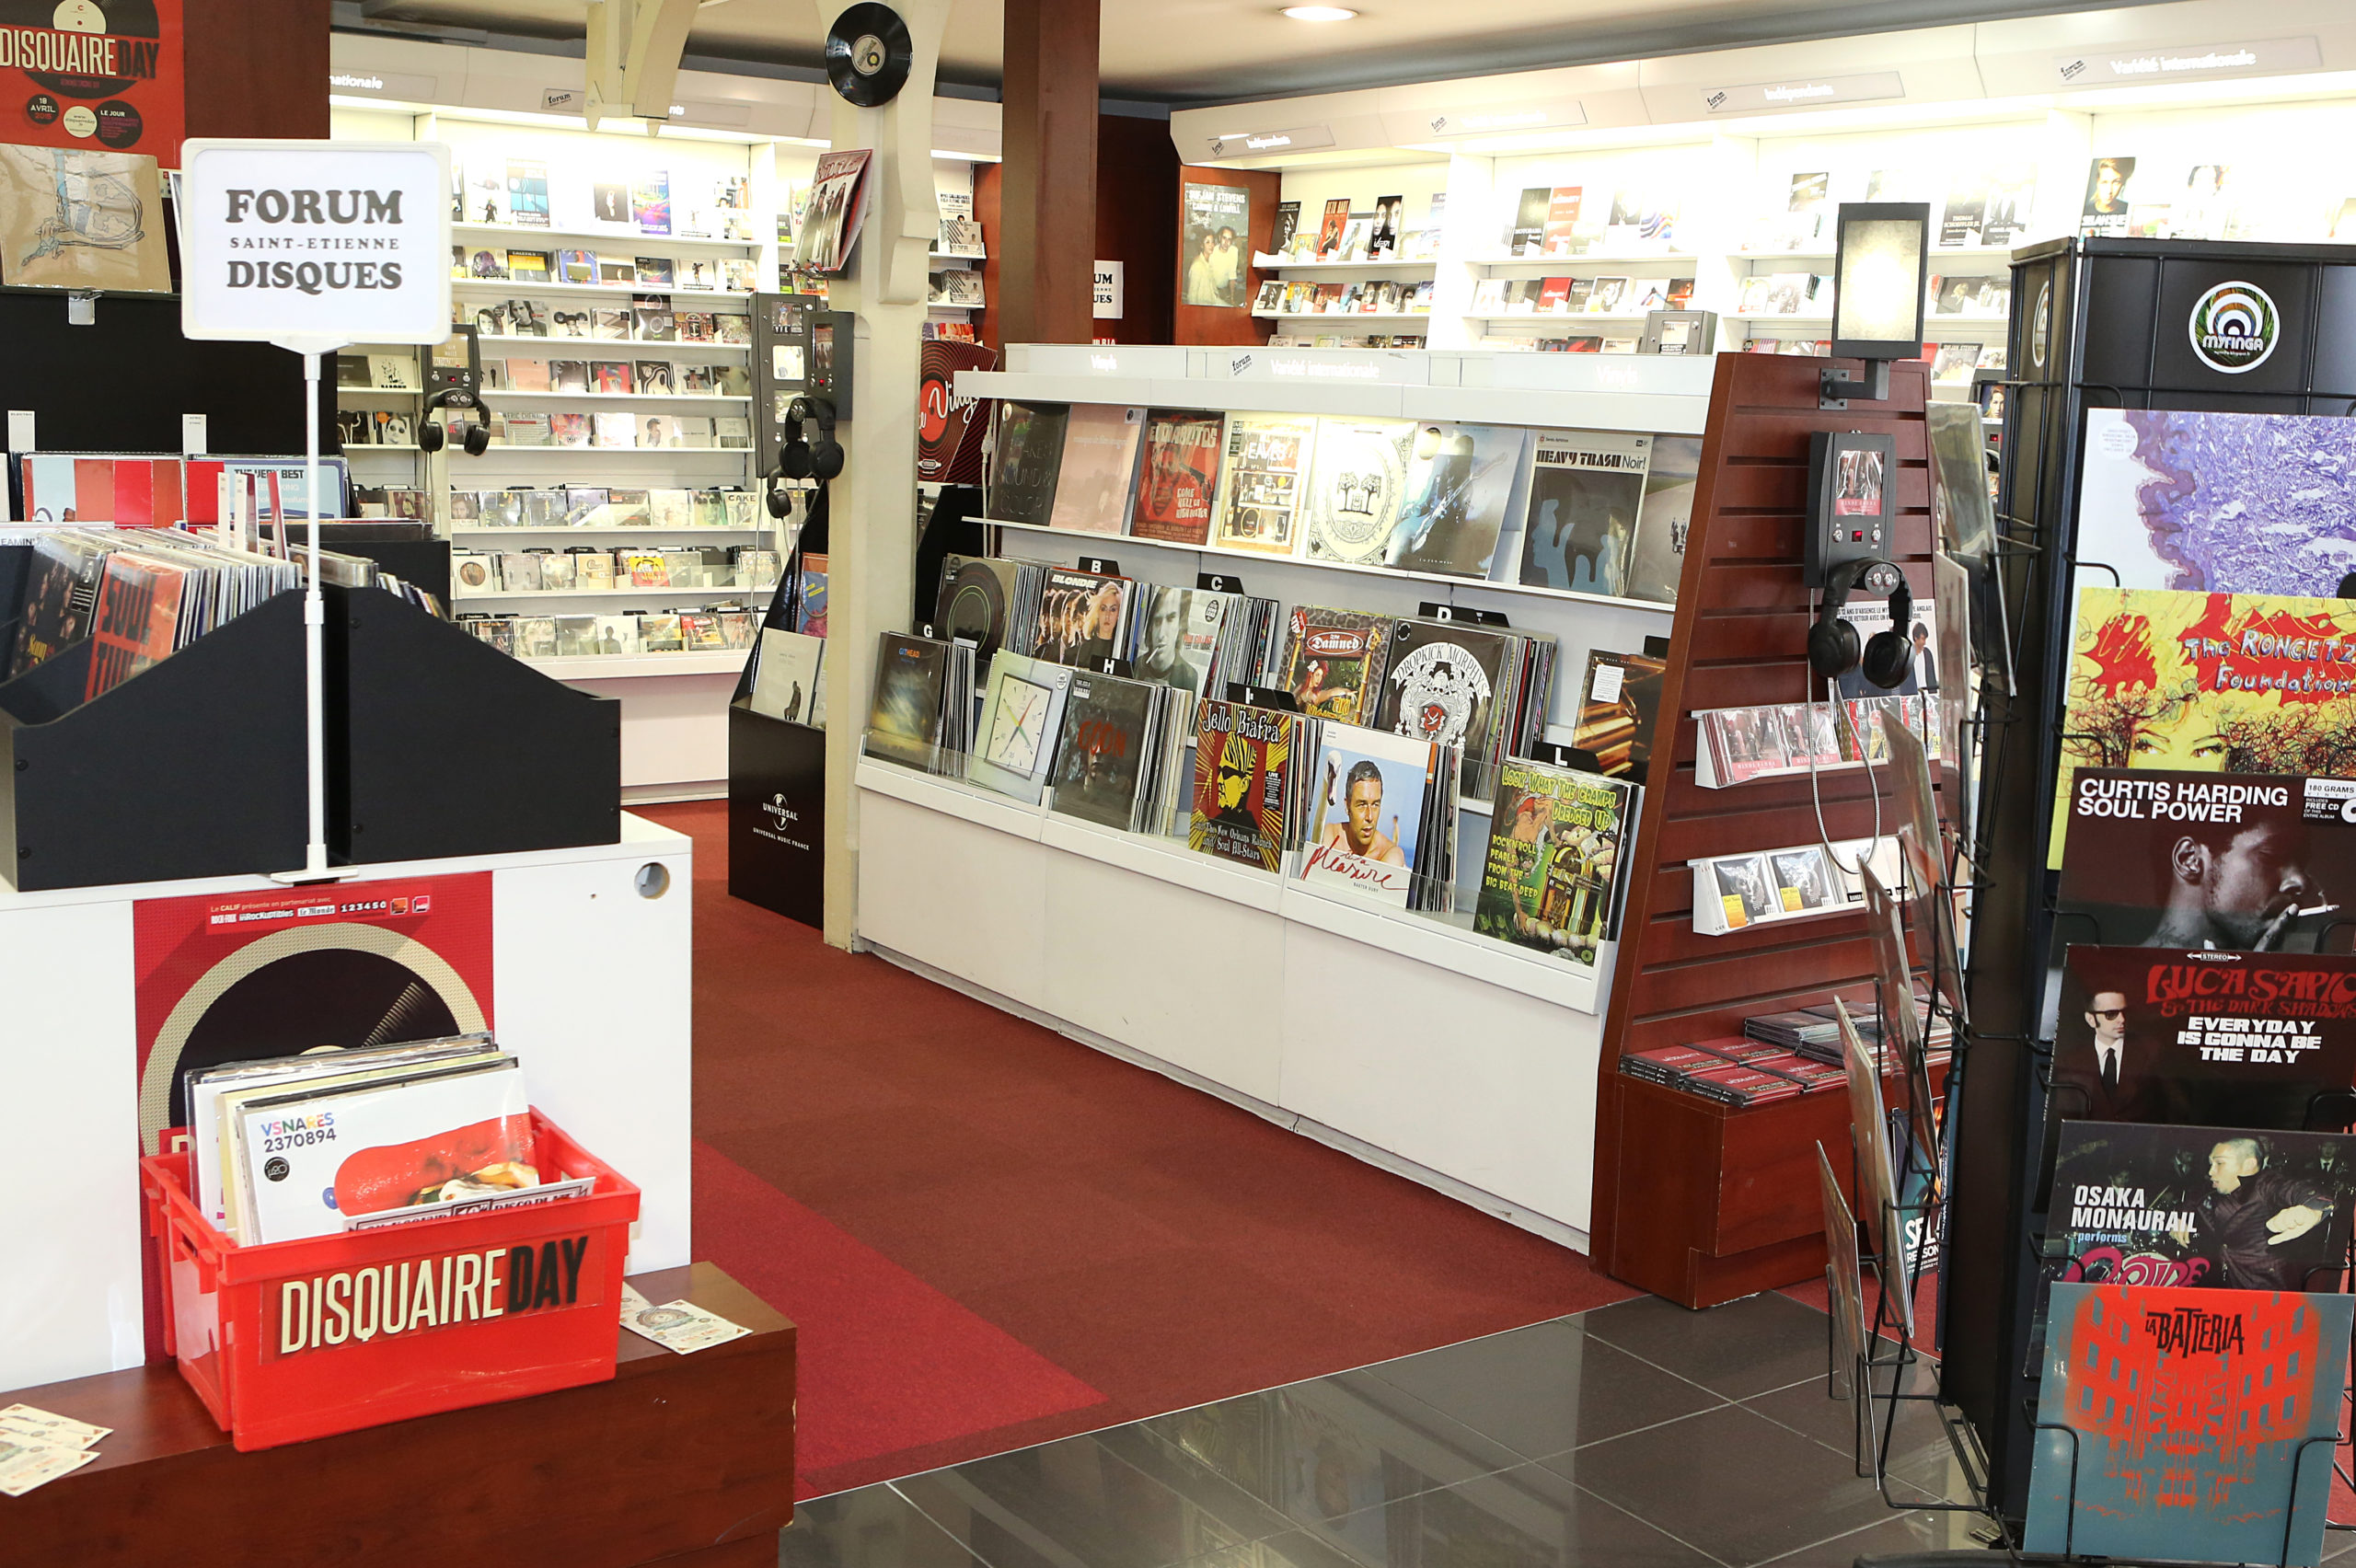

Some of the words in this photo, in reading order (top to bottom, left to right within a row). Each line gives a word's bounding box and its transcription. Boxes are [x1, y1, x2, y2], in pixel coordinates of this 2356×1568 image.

[0, 29, 116, 75] DISQUAIRE
[118, 40, 159, 79] DAY
[548, 93, 572, 104] forum
[1707, 90, 1727, 108] forum
[30, 105, 55, 113] AVRIL
[225, 189, 403, 225] FORUM
[1216, 192, 1245, 203] STEVENS
[229, 236, 399, 249] SAINT-ETIENNE
[226, 260, 402, 294] DISQUES
[1232, 354, 1253, 372] forum
[1536, 450, 1577, 465] HEAVY
[1580, 453, 1621, 467] TRASH
[1622, 455, 1646, 469] Noir!
[282, 469, 304, 478] BEST
[728, 494, 756, 502] CAKE
[1091, 560, 1102, 573] B
[1052, 574, 1098, 589] BLONDIE
[1211, 576, 1223, 591] C
[1438, 606, 1452, 620] D
[923, 624, 933, 638] G
[1311, 636, 1359, 650] Damned
[2184, 637, 2231, 660] The
[1103, 658, 1115, 674] H
[1397, 644, 1445, 680] DROPKICK
[1447, 645, 1487, 697] MURPHYS
[2215, 664, 2352, 694] Foundation
[1333, 697, 1351, 716] TIKI
[1203, 703, 1231, 732] Jello
[1237, 710, 1280, 743] Biafra
[1078, 720, 1126, 758] GOON
[1554, 747, 1568, 767] L
[1502, 766, 1526, 789] LOOK
[1530, 772, 1556, 795] WHAT
[1558, 778, 1577, 800] THE
[1578, 784, 1617, 810] CRAMPS
[2080, 778, 2171, 801] CURTIS
[2177, 783, 2289, 806] HARDING
[763, 802, 798, 821] UNIVERSAL
[1552, 801, 1593, 826] DREDGED
[1595, 810, 1611, 832] UP
[2077, 798, 2145, 818] SOUL
[2152, 801, 2243, 823] POWER
[753, 827, 776, 840] UNIVERSAL
[777, 835, 791, 845] MUSIC
[792, 840, 809, 850] FRANCE
[1217, 838, 1230, 851] Soul
[1231, 841, 1261, 860] All-Stars
[1490, 848, 1517, 863] PEARLS
[1299, 836, 1409, 890] pleasure
[1488, 862, 1507, 876] FROM
[1509, 867, 1524, 881] THE
[1485, 875, 1497, 888] BIG
[1499, 880, 1518, 893] BEAT
[1519, 884, 1539, 898] DEEP
[242, 902, 270, 910] présente
[280, 898, 316, 907] partenariat
[308, 905, 335, 916] Monde
[2146, 964, 2247, 1004] LUCA
[2187, 998, 2223, 1013] THE
[2227, 999, 2273, 1015] DARK
[2188, 1017, 2316, 1034] EVERYDAY
[2177, 1031, 2201, 1044] IS
[2204, 1032, 2286, 1049] GONNA
[2291, 1035, 2322, 1050] BE
[2200, 1047, 2244, 1062] THE
[2250, 1049, 2300, 1064] DAY
[261, 1113, 334, 1136] VSNARES
[264, 1128, 337, 1152] 2370894
[2074, 1184, 2144, 1208] OSAKA
[2071, 1206, 2197, 1233] MONAURAIL
[2078, 1231, 2127, 1243] performs
[1907, 1244, 1939, 1263] RESON
[281, 1248, 506, 1355] DISQUAIRE
[507, 1236, 588, 1314] DAY
[2145, 1319, 2156, 1336] LA
[2147, 1307, 2245, 1358] BATTERIA
